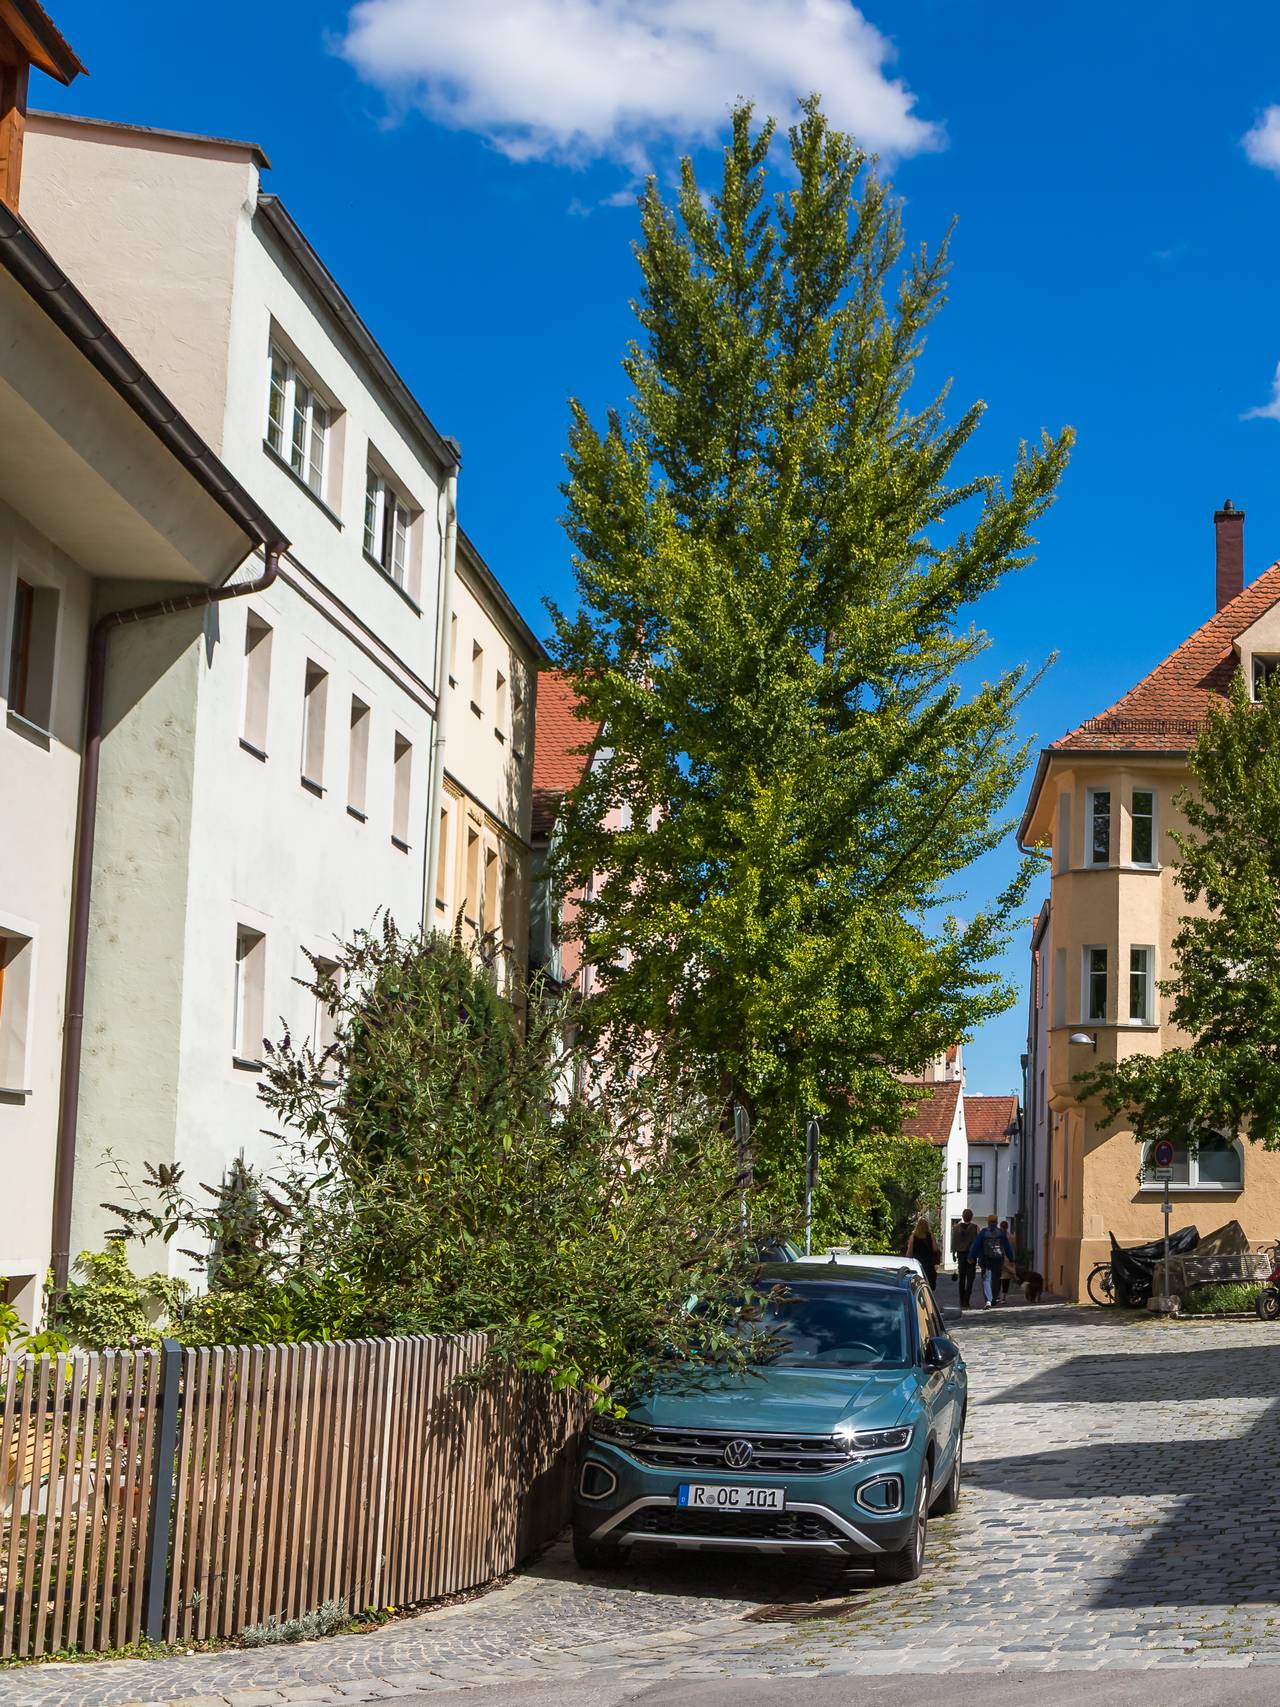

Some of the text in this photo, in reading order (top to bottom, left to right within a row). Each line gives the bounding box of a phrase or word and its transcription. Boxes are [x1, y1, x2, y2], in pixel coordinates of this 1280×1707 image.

[693, 1487, 705, 1505] R
[716, 1488, 739, 1506] OC
[745, 1489, 778, 1508] 101
